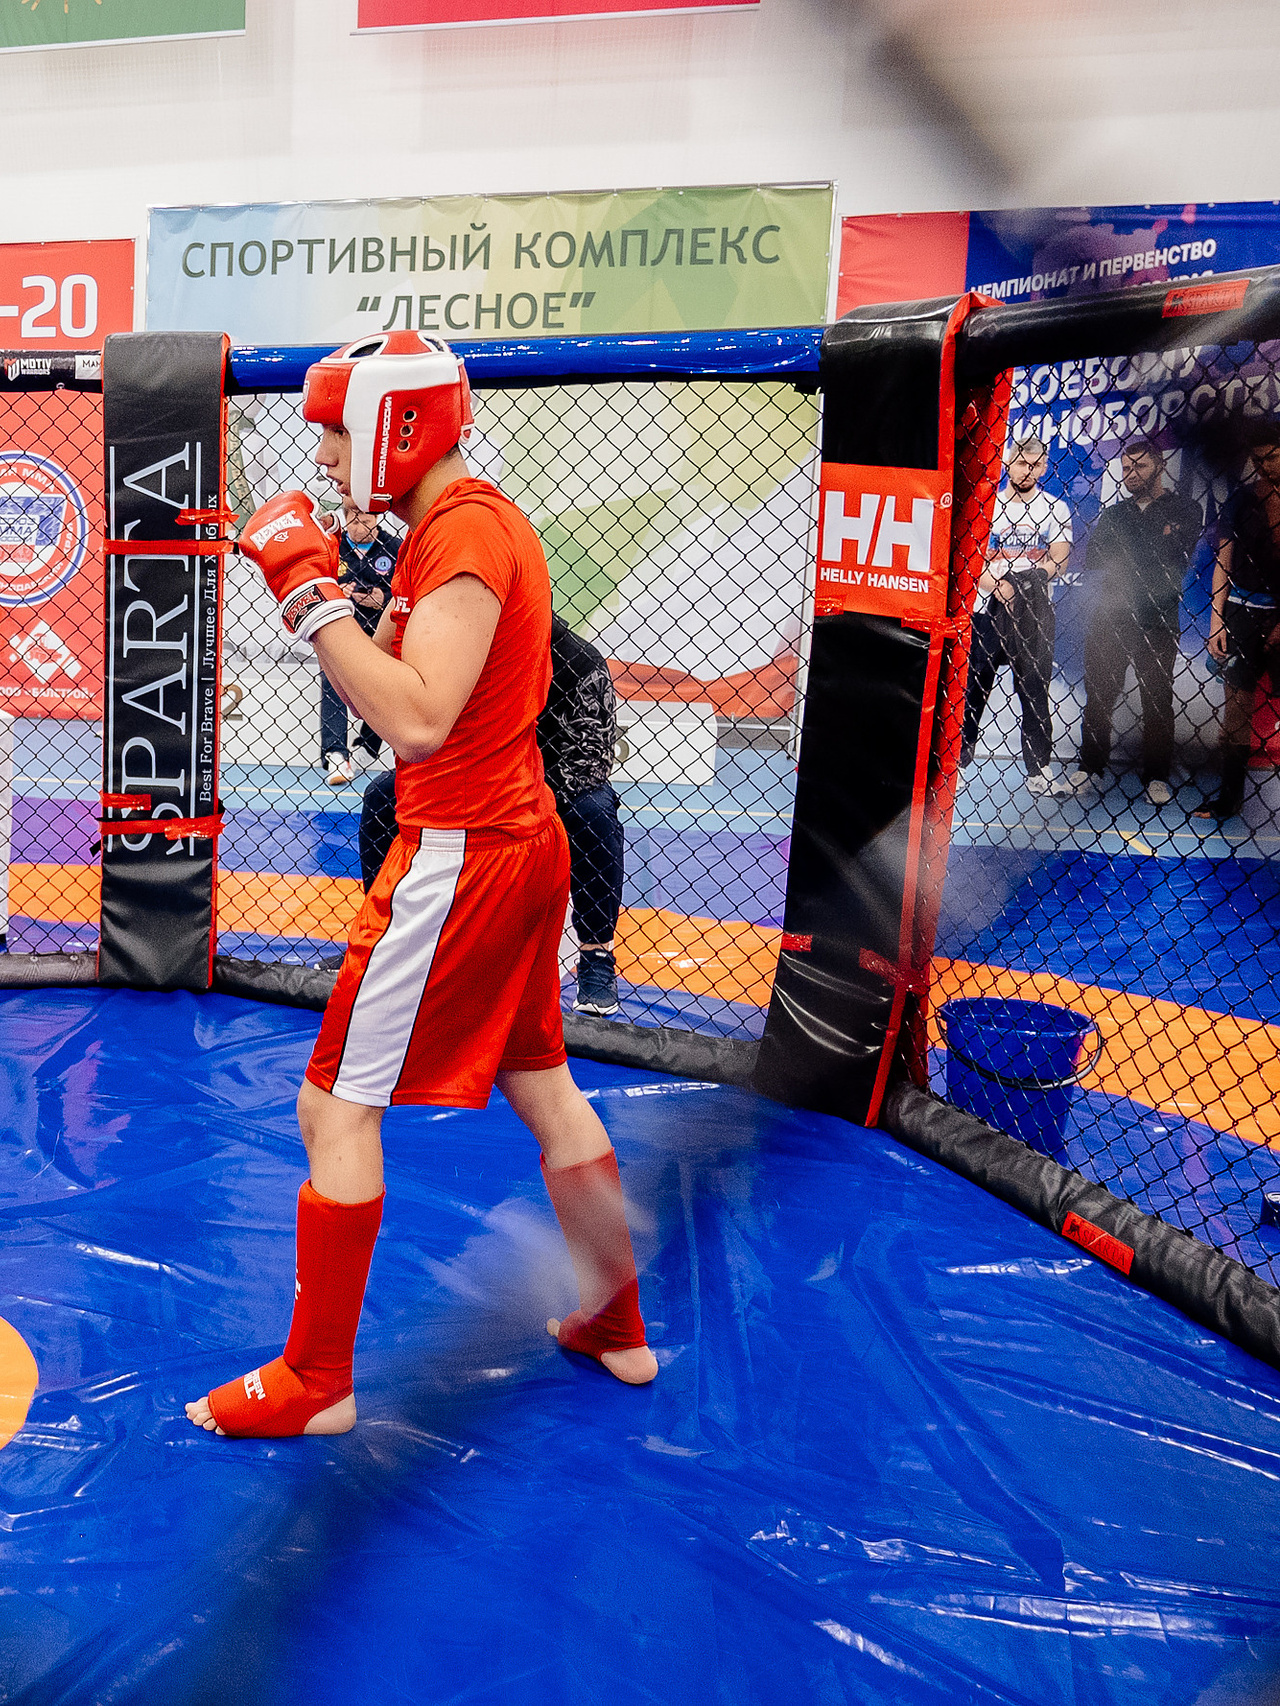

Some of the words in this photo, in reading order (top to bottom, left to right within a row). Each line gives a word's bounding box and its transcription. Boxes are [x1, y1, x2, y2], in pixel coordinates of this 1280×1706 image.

[182, 222, 491, 278] СПОРТИВНЫЙ
[514, 225, 781, 269] КОМПЛЕКС
[1084, 264, 1098, 280] И
[1099, 238, 1217, 277] ПЕРВЕНСТВО
[1186, 286, 1238, 311] SPARTA
[21, 357, 52, 370] MOTIV
[1012, 346, 1202, 409] БОЕВОМУ
[21, 467, 55, 493] ММА
[204, 569, 218, 602] Для
[820, 567, 864, 585] HELLY
[867, 573, 929, 593] HANSEN
[121, 442, 189, 855] SPARTA
[202, 606, 218, 669] Лучшее
[200, 687, 214, 733] Brave
[200, 736, 213, 763] For
[199, 770, 212, 802] Best
